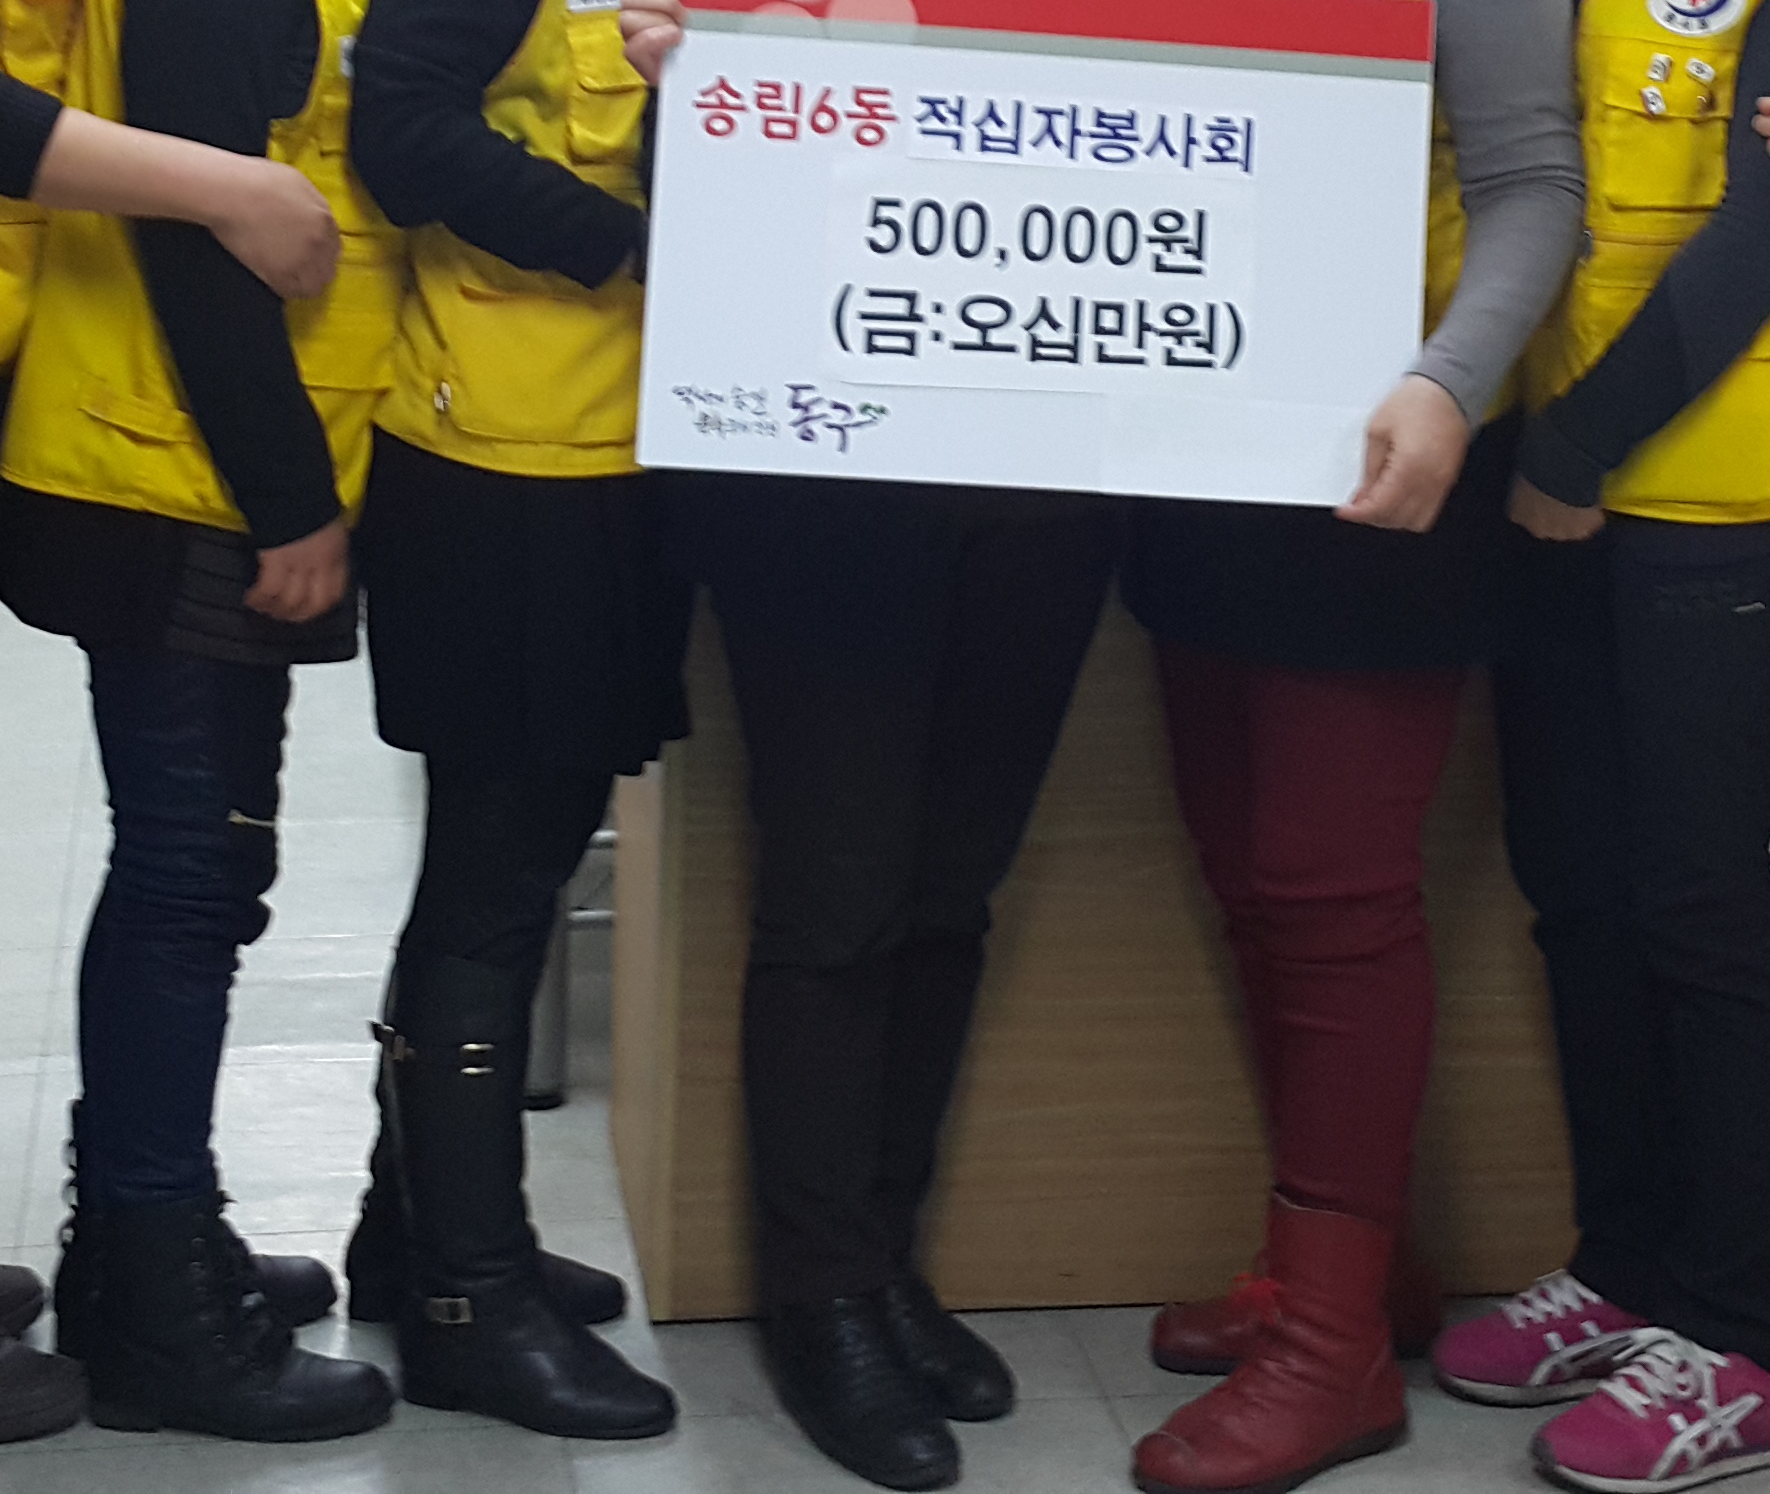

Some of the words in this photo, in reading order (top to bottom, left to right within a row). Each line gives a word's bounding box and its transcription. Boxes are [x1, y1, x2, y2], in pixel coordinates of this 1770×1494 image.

[692, 74, 900, 148] 송림6동
[914, 94, 1254, 175] 적십자봉사회
[865, 196, 1208, 277] 500,000원
[831, 282, 1247, 370] (금:오십만원)
